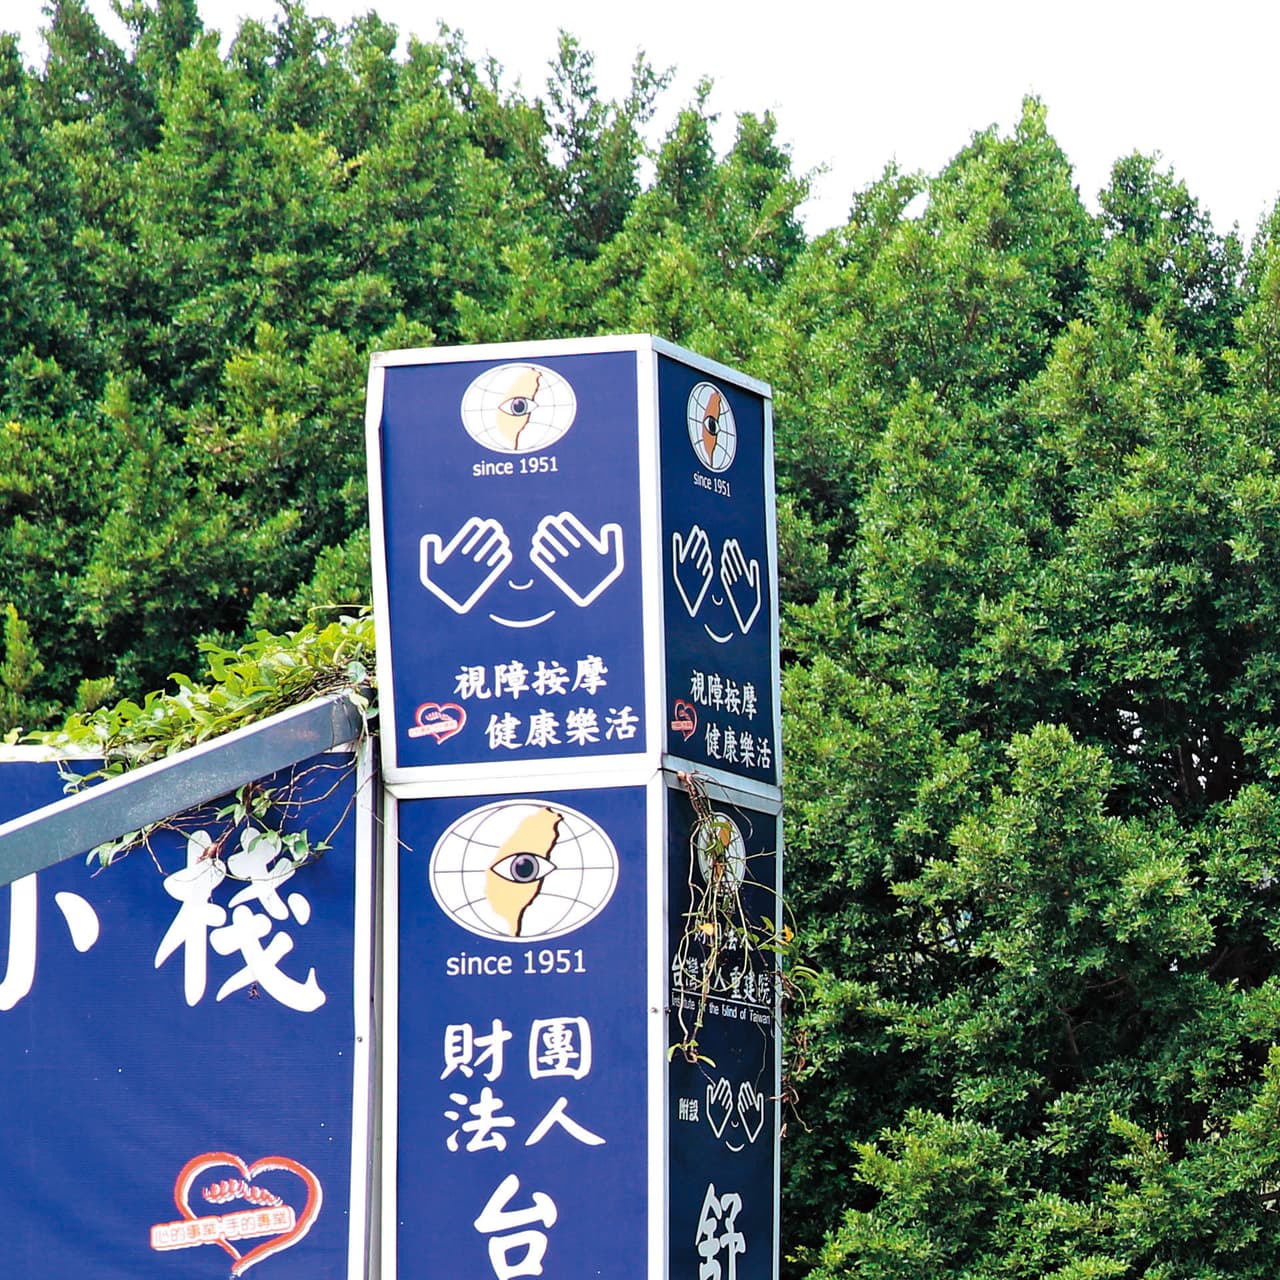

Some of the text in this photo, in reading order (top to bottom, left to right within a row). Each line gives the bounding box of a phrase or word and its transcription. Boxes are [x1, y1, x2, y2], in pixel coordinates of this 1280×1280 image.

[473, 456, 558, 477] since 1951
[693, 472, 731, 497] since 1951
[453, 655, 608, 701] 視障按摩
[690, 669, 758, 721] 視障按摩
[485, 706, 639, 749] 健康樂活
[704, 722, 772, 769] 健康樂活
[446, 949, 587, 975] since 1951
[749, 1009, 771, 1026] Taiwan
